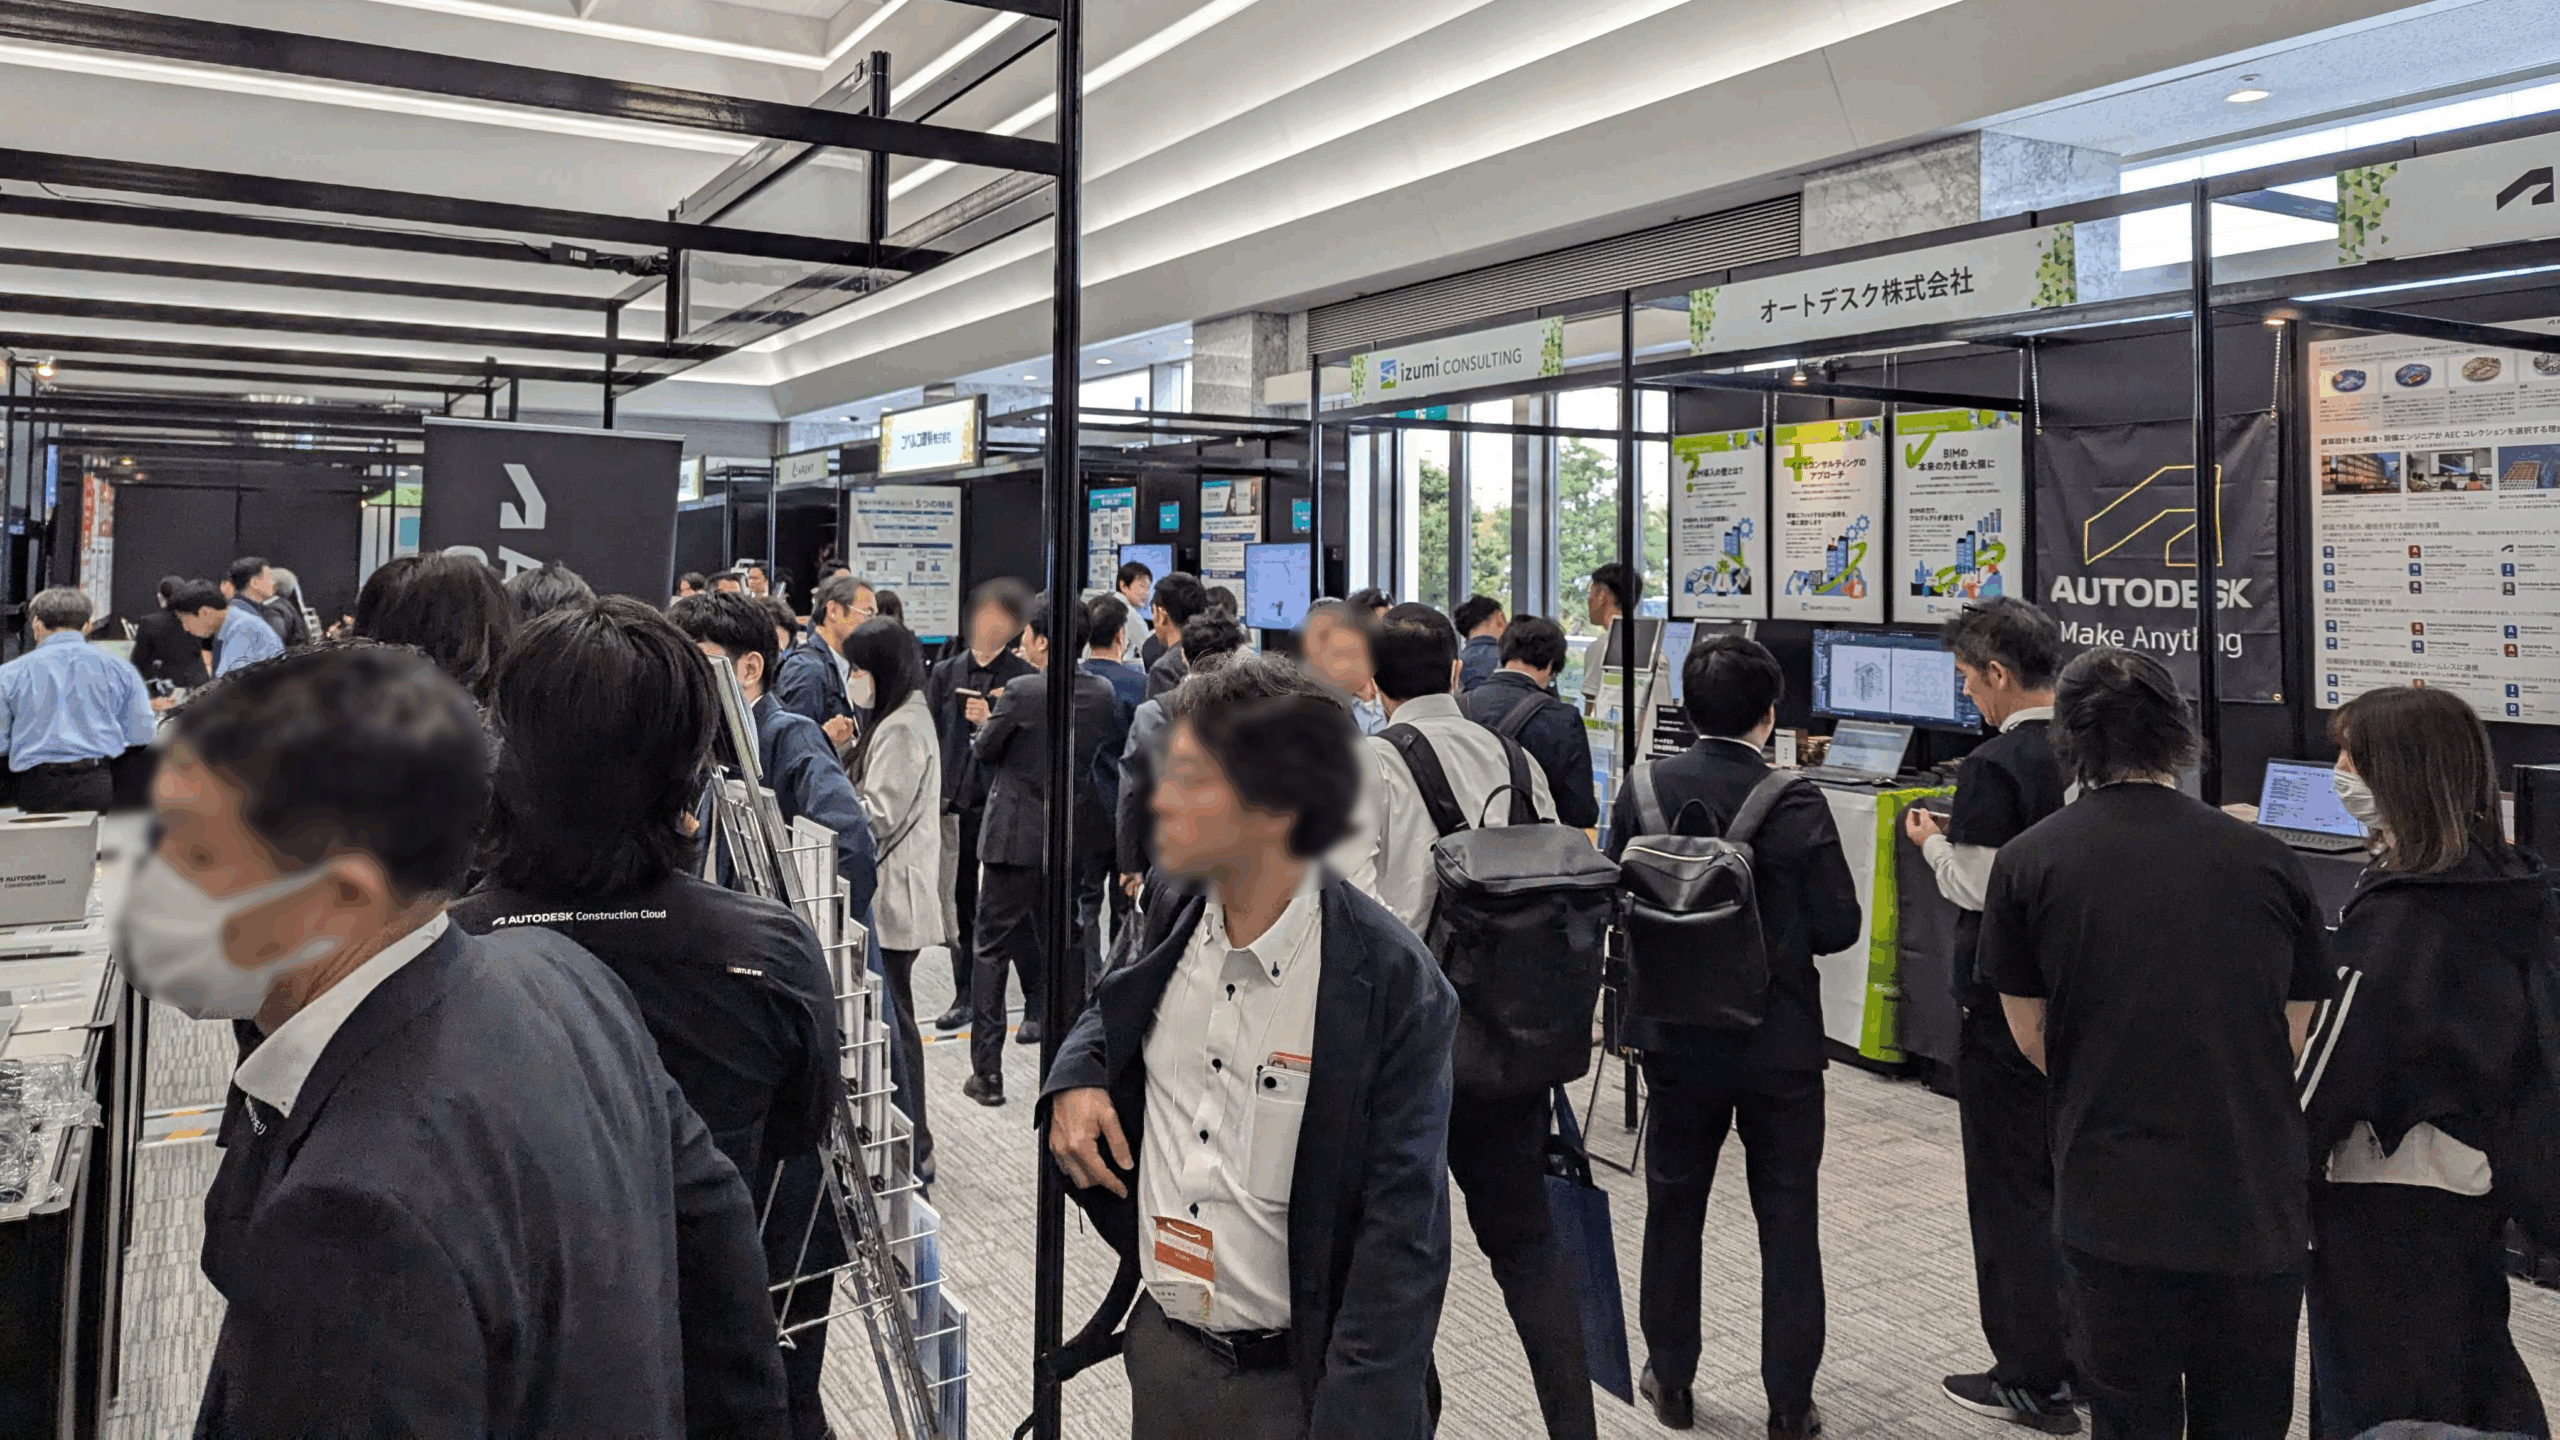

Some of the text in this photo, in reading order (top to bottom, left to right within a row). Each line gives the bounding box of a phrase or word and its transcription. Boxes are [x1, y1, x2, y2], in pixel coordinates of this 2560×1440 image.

[1760, 265, 1975, 324] オートデスク株式会社
[1401, 347, 1523, 382] izumi CONSULTING
[2445, 430, 2460, 439] AEC
[1943, 448, 1968, 459] BIMの
[1918, 459, 1996, 472] 本来の力を最大限に
[1809, 470, 1845, 481] アプローチ
[2051, 575, 2253, 610] AUTODESK
[2059, 620, 2243, 659] Make Anytng
[4, 878, 66, 889] Construction Cloud
[5, 874, 47, 883] AUTODESK
[507, 909, 667, 926] AUTODESK Construction Cloud
